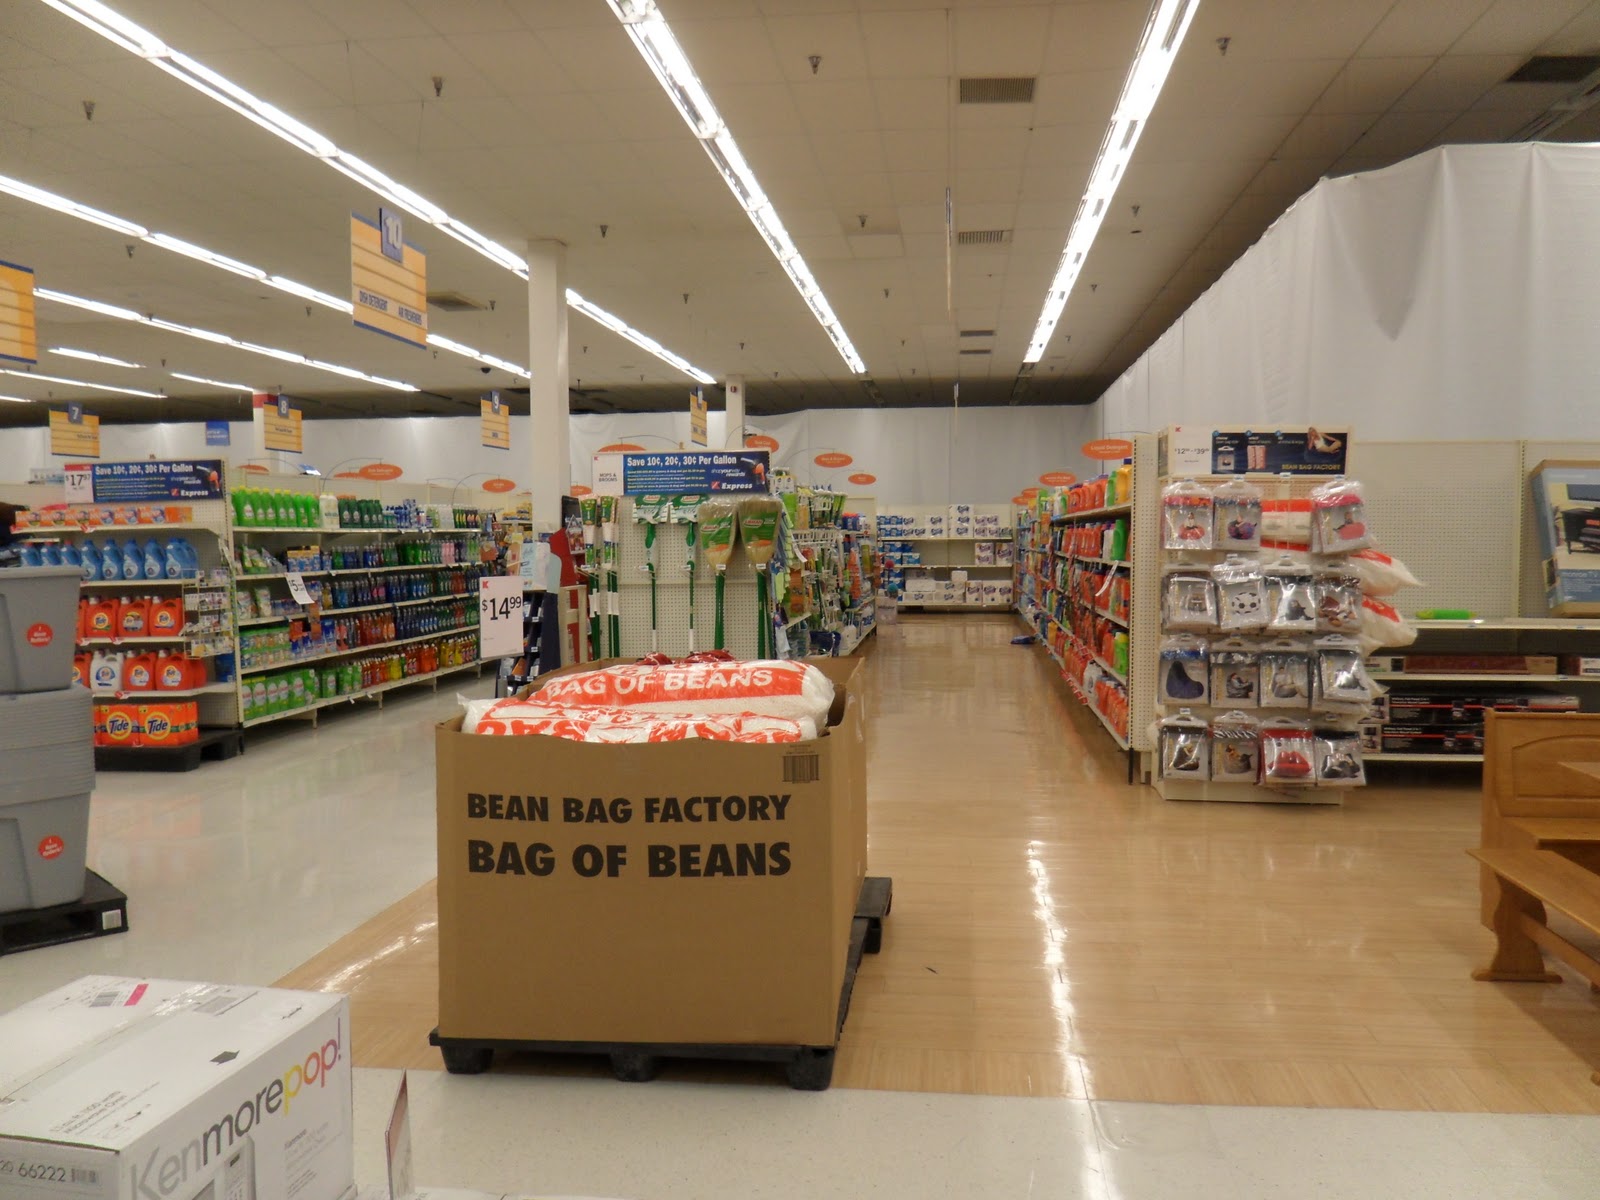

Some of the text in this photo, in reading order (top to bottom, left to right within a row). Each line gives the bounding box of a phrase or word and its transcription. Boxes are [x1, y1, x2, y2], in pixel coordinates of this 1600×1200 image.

[384, 217, 402, 249] 10
[281, 401, 287, 414] 8
[494, 395, 499, 409] 9
[72, 406, 79, 419] 7
[627, 455, 737, 467] Save 10¢, 20¢, 30¢ Per Gallon
[95, 466, 112, 475] Save
[159, 464, 170, 474] Per
[172, 463, 193, 473] Gallon
[721, 482, 753, 490] Express
[181, 489, 208, 498] Express
[547, 669, 773, 699] BAG OF BEANS
[109, 719, 129, 734] Tide
[148, 719, 168, 734] Tide
[467, 793, 792, 824] BEAN BAG FACTORY
[468, 840, 792, 878] BAG OF BEANS
[18, 1162, 66, 1182] 66222
